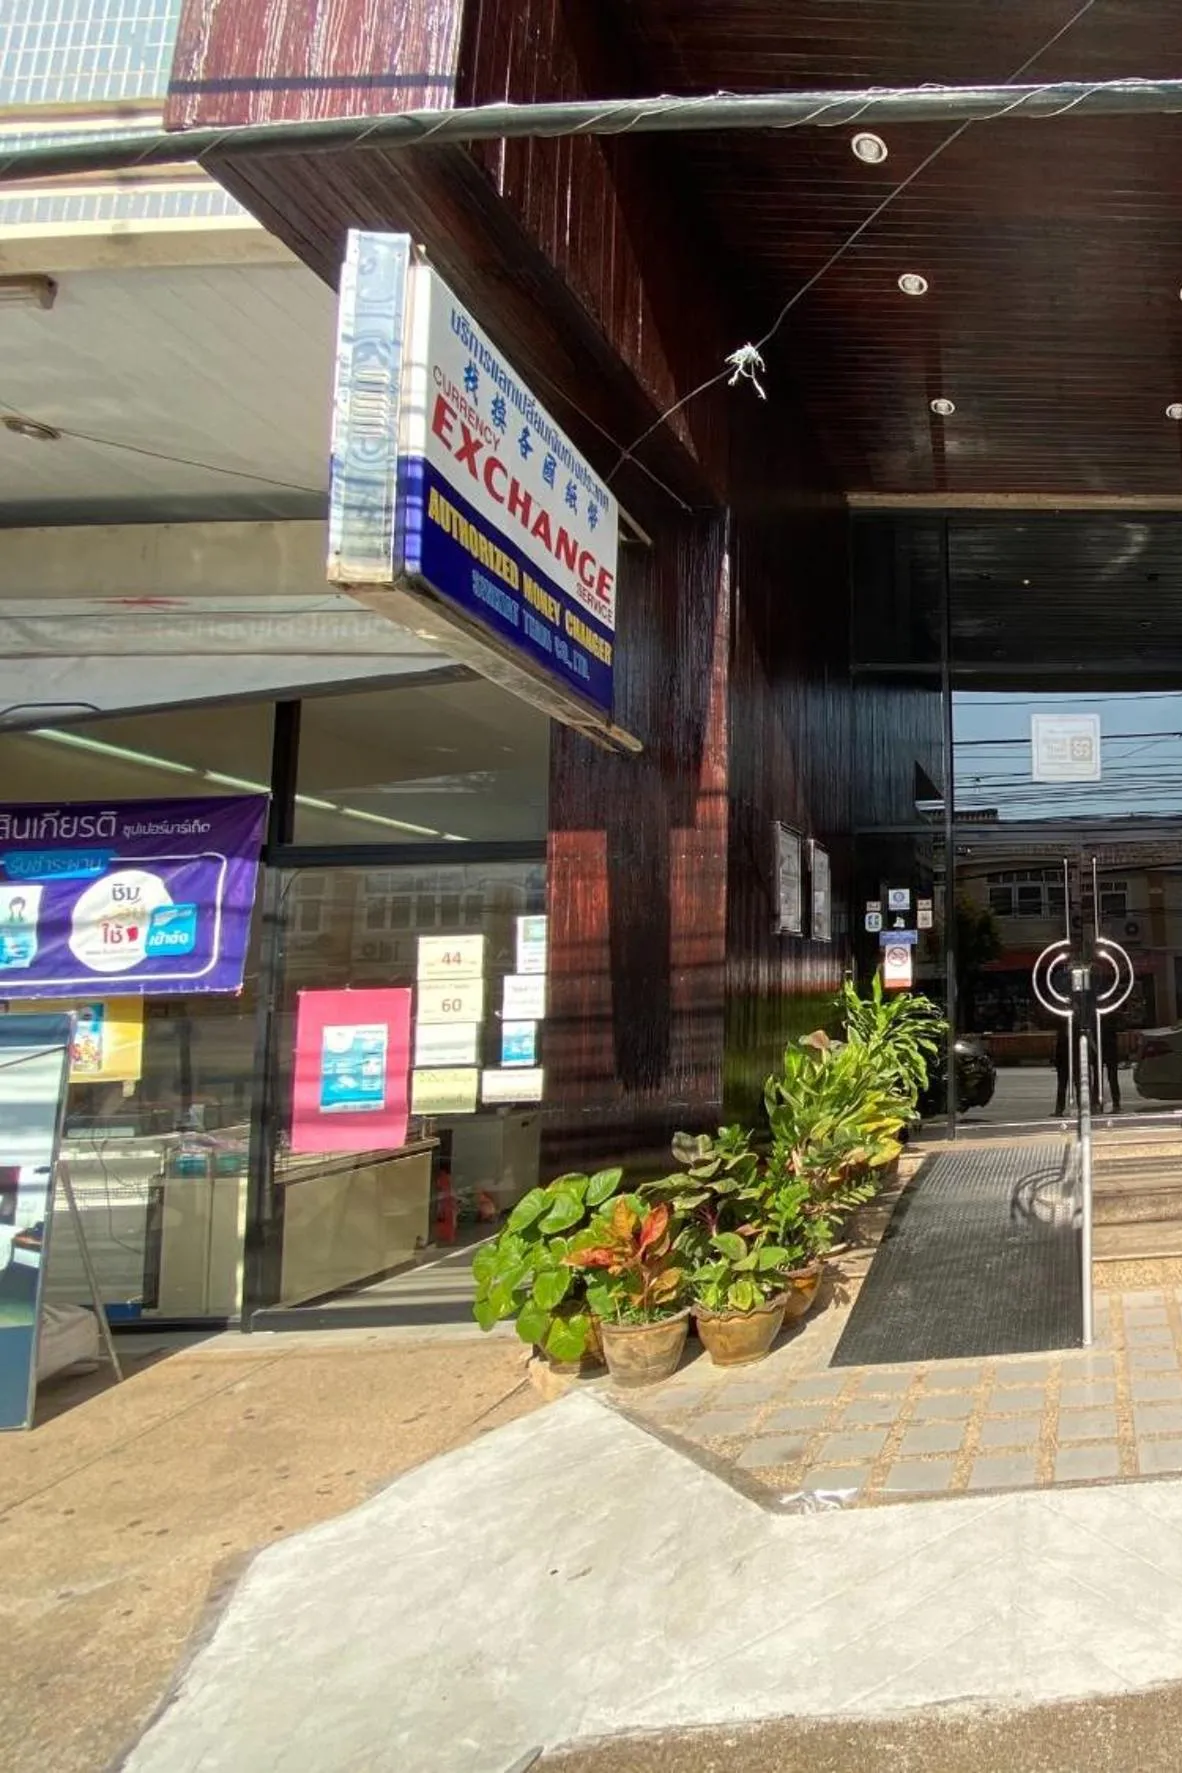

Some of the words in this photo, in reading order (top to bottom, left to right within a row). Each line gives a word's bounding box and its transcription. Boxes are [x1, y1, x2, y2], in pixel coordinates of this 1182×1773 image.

[433, 365, 500, 451] CURRENCY
[431, 393, 614, 604] EXCHANGE
[428, 486, 519, 590] AUTHORIZED
[523, 571, 561, 626] MONEY
[565, 609, 612, 666] CHANGER
[576, 583, 614, 623] SERVICE
[441, 951, 462, 965] 44
[441, 997, 462, 1012] 60
